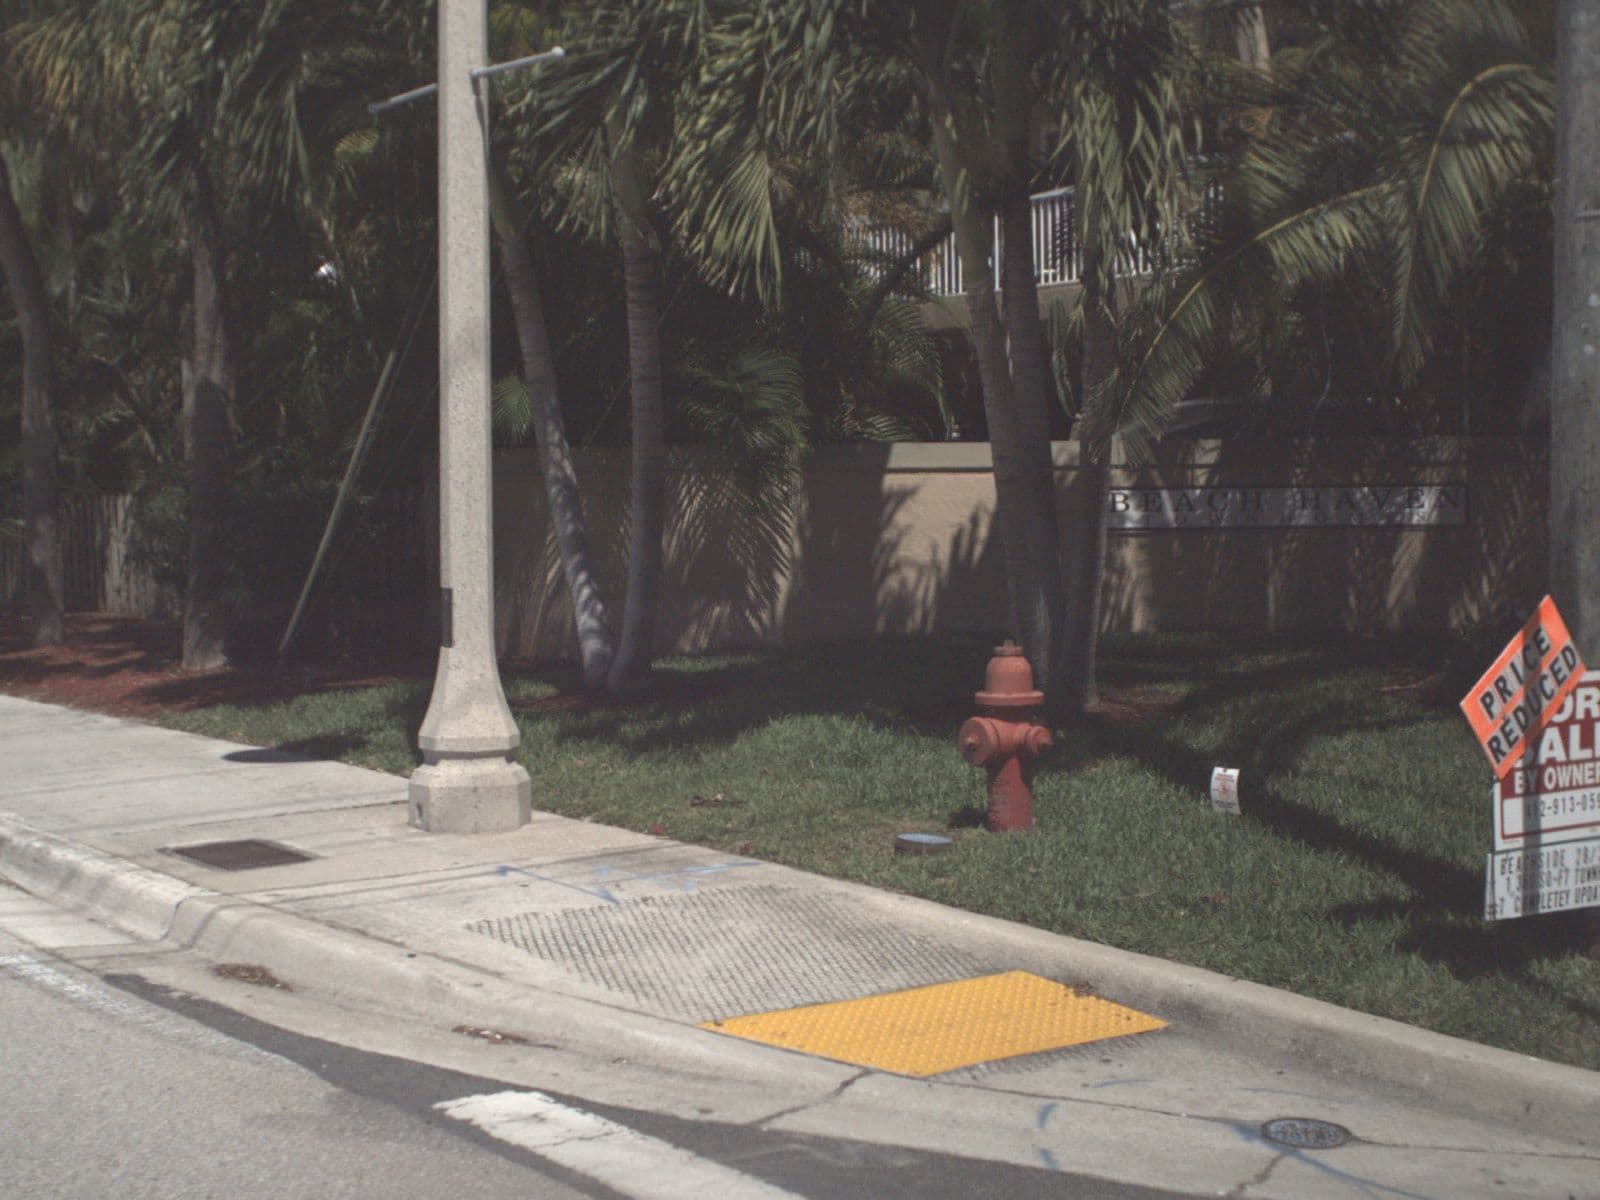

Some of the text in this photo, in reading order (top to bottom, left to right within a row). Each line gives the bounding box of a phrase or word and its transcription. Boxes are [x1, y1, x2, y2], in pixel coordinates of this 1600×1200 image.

[1110, 488, 1459, 513] BEACH HAVEN
[1480, 624, 1550, 720] PRICE
[1488, 646, 1577, 764] REDUCED
[1552, 687, 1600, 723] OR
[1515, 721, 1600, 768] AL
[1514, 767, 1538, 796] BY
[1575, 882, 1600, 904] UPDA
